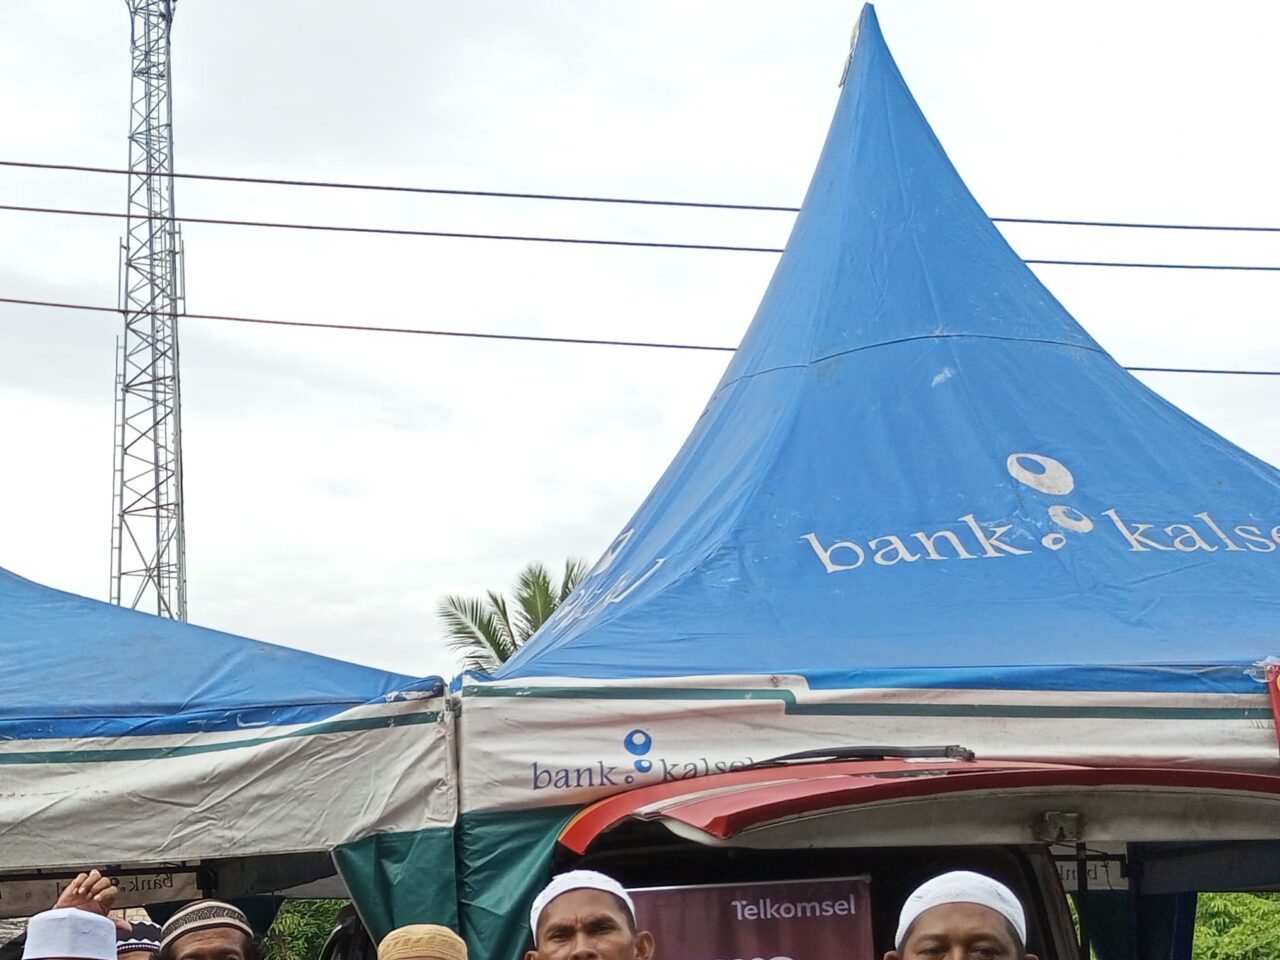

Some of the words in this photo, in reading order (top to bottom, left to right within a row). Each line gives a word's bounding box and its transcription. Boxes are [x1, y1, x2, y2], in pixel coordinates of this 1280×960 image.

[799, 513, 1033, 574] bank
[529, 760, 622, 790] bank
[731, 894, 856, 920] Telkomsel
